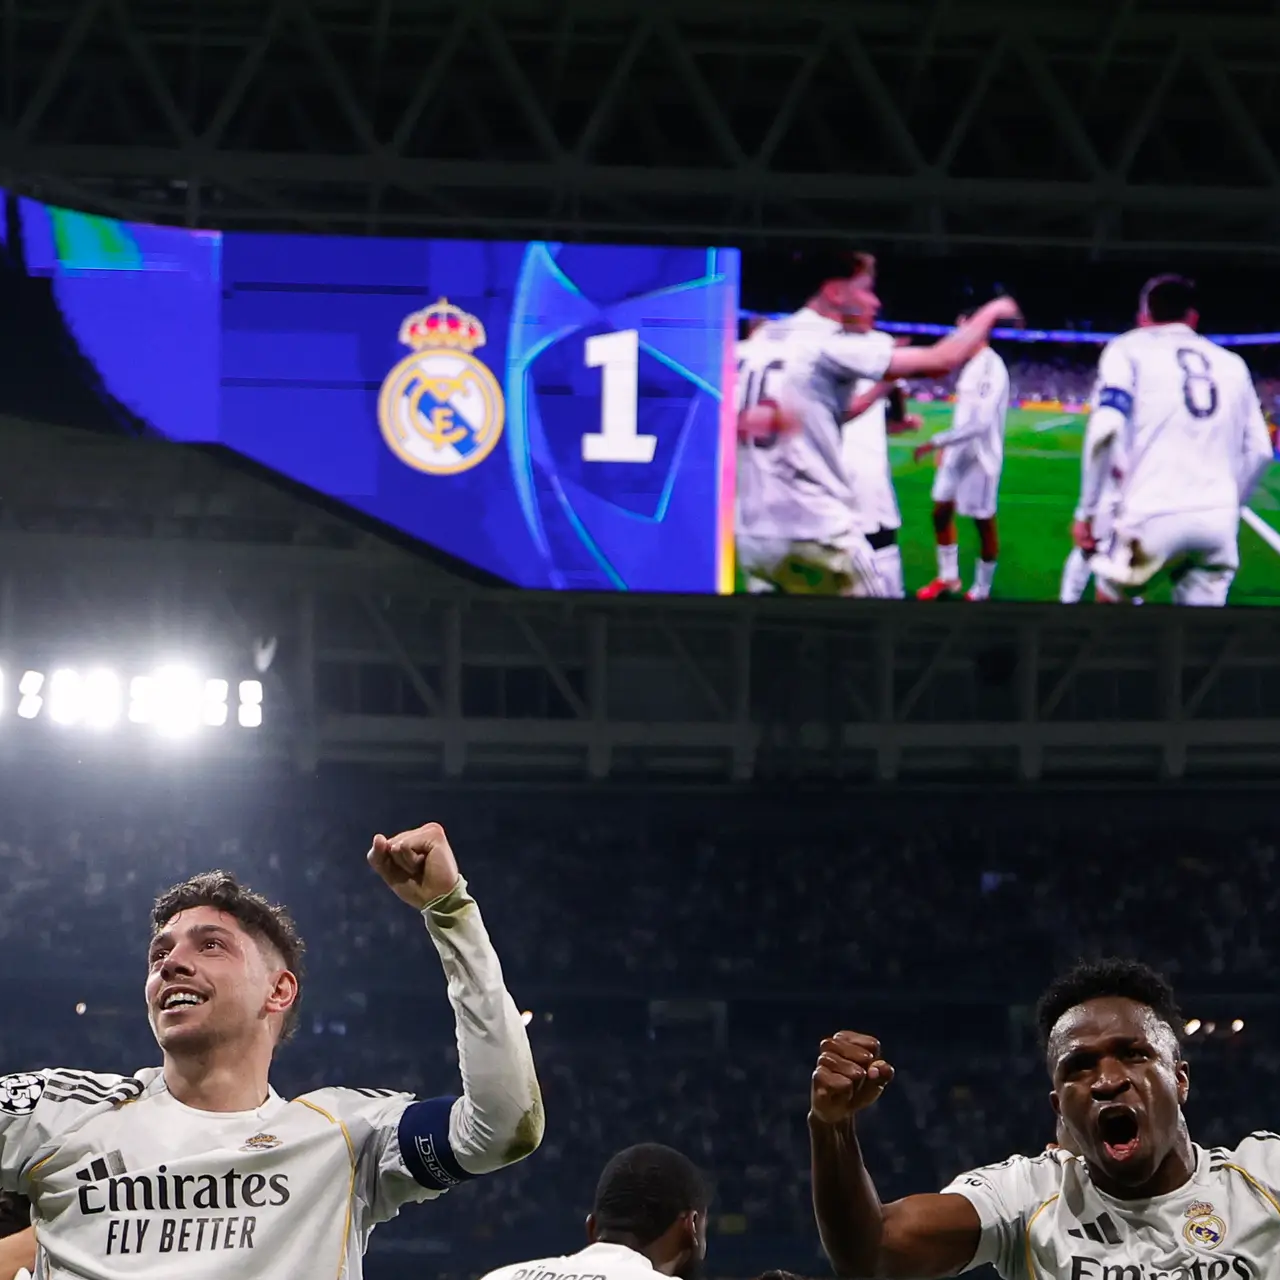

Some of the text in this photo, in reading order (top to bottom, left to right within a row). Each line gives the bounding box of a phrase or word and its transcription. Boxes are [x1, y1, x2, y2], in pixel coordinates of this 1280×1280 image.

[581, 329, 658, 463] 1
[78, 1164, 290, 1215] Emirates
[106, 1216, 256, 1255] FLY BETTER
